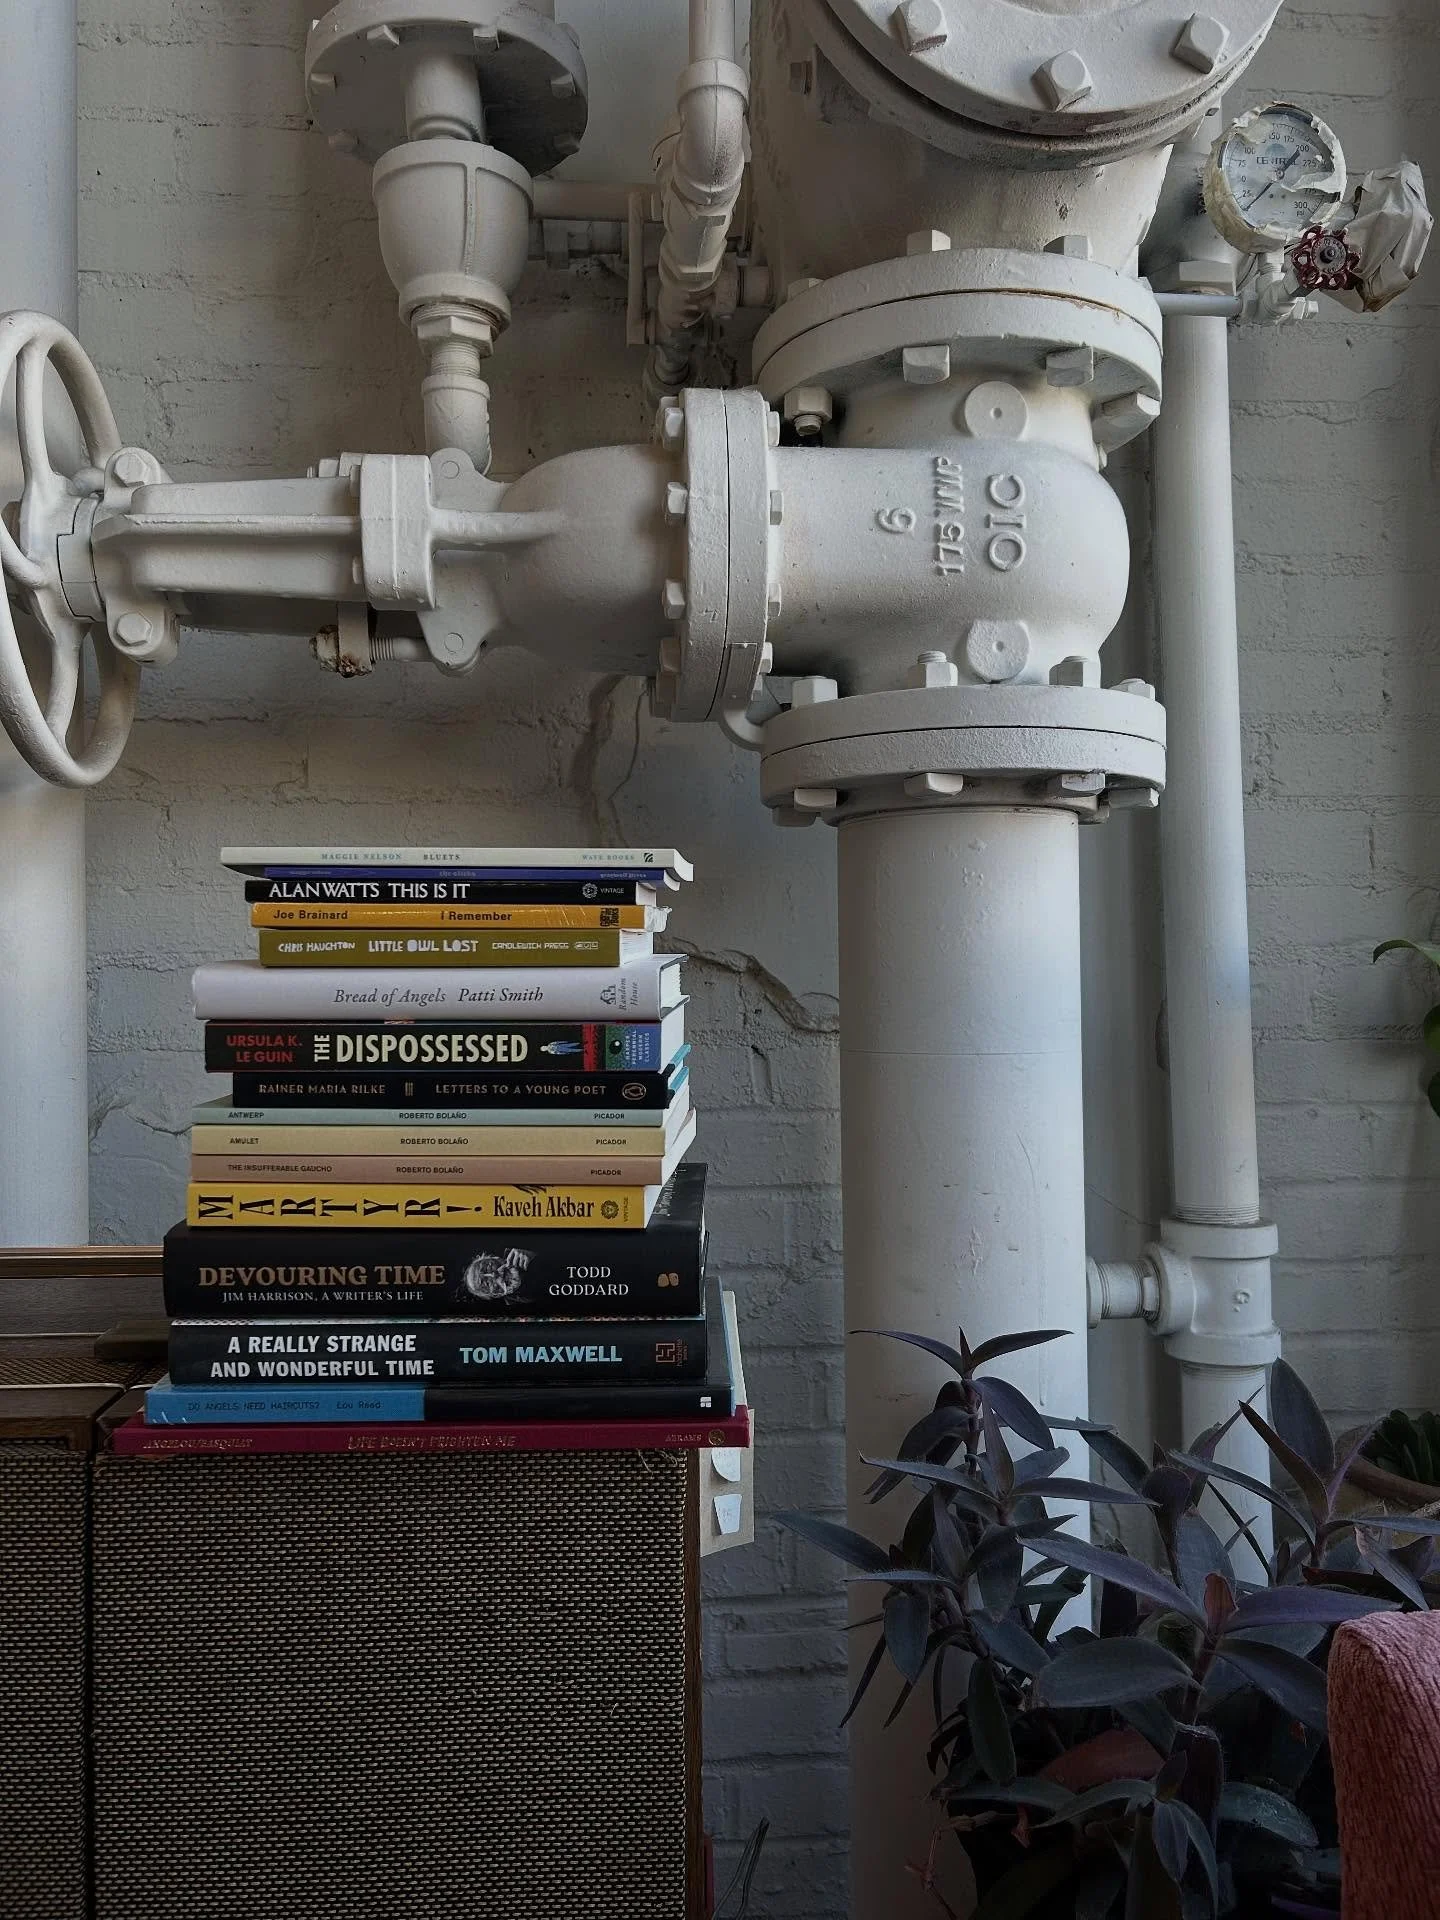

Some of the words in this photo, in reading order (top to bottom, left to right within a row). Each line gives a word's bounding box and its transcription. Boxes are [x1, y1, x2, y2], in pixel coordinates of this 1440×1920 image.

[1283, 135, 1294, 143] 175
[877, 507, 916, 534] 6
[987, 473, 1027, 573] OIC
[935, 522, 965, 576] 175
[269, 883, 321, 898] ALAN
[322, 883, 380, 898] WATTS
[388, 883, 428, 898] THIS
[434, 883, 448, 899] IS
[452, 883, 470, 899] IT
[274, 910, 294, 919] Joe
[299, 910, 348, 920] Brainard
[440, 911, 444, 920] I
[449, 911, 512, 921] Remember
[278, 943, 303, 953] CHRIS
[306, 942, 356, 952] HAUGHTON
[368, 940, 403, 952] LITTLE
[407, 940, 439, 952] OWL
[444, 940, 478, 952] LOST
[492, 942, 542, 950] CANDLEWICK
[544, 942, 570, 950] PRESS
[332, 990, 377, 1003] Bread
[382, 988, 400, 1007] of
[398, 988, 446, 1006] Angels
[458, 988, 496, 1002] Patti
[500, 987, 544, 1002] Smith
[618, 978, 627, 1011] Random
[631, 981, 639, 1006] House
[226, 1035, 284, 1046] URSULA
[288, 1035, 302, 1046] K.
[314, 1034, 330, 1062] THE
[336, 1034, 528, 1063] DISPOSSESSED
[236, 1051, 250, 1062] LE
[254, 1051, 293, 1063] GUIN
[259, 1083, 304, 1094] RAINER
[308, 1084, 347, 1094] MARIA
[352, 1084, 386, 1094] RILKE
[436, 1084, 488, 1094] LETTERS
[492, 1084, 508, 1094] TO
[514, 1085, 522, 1094] A
[526, 1084, 570, 1095] YOUNG
[574, 1085, 606, 1095] POET
[436, 1110, 467, 1119] BOLAÑO
[594, 1112, 624, 1120] PICADOR
[438, 1136, 468, 1144] BOLAÑO
[228, 1164, 242, 1172] THE
[244, 1164, 299, 1172] INSUFFERABLE
[434, 1166, 464, 1174] BOLAÑO
[198, 1195, 482, 1220] MARTYR!
[494, 1196, 542, 1218] Kaveh
[546, 1196, 595, 1218] Akbar
[198, 1266, 368, 1287] DEVOURING
[374, 1265, 446, 1285] TIME
[566, 1266, 611, 1278] TODD
[222, 1292, 244, 1304] JIM
[248, 1292, 318, 1302] HARRISON,
[322, 1292, 330, 1301] A
[332, 1290, 392, 1301] WRITER'S
[397, 1291, 424, 1301] LIFE
[549, 1284, 629, 1296] GODDARD
[228, 1336, 241, 1354] A
[249, 1336, 320, 1354] REALLY
[326, 1334, 416, 1352] STRANGE
[460, 1346, 508, 1364] TOM
[516, 1346, 622, 1363] MAXWELL
[210, 1361, 250, 1378] AND
[258, 1360, 378, 1377] WONDERFUL
[385, 1360, 434, 1376] TIME
[188, 1402, 201, 1411] DO
[205, 1402, 239, 1410] ANGELS
[243, 1402, 266, 1410] NEED
[270, 1401, 320, 1410] HAIRCUTS?
[336, 1400, 354, 1410] Lou
[348, 1436, 378, 1450] LIFE
[430, 1436, 492, 1448] FRIGHTEN
[496, 1436, 516, 1447] ME
[664, 1434, 702, 1442] ABRAMS
